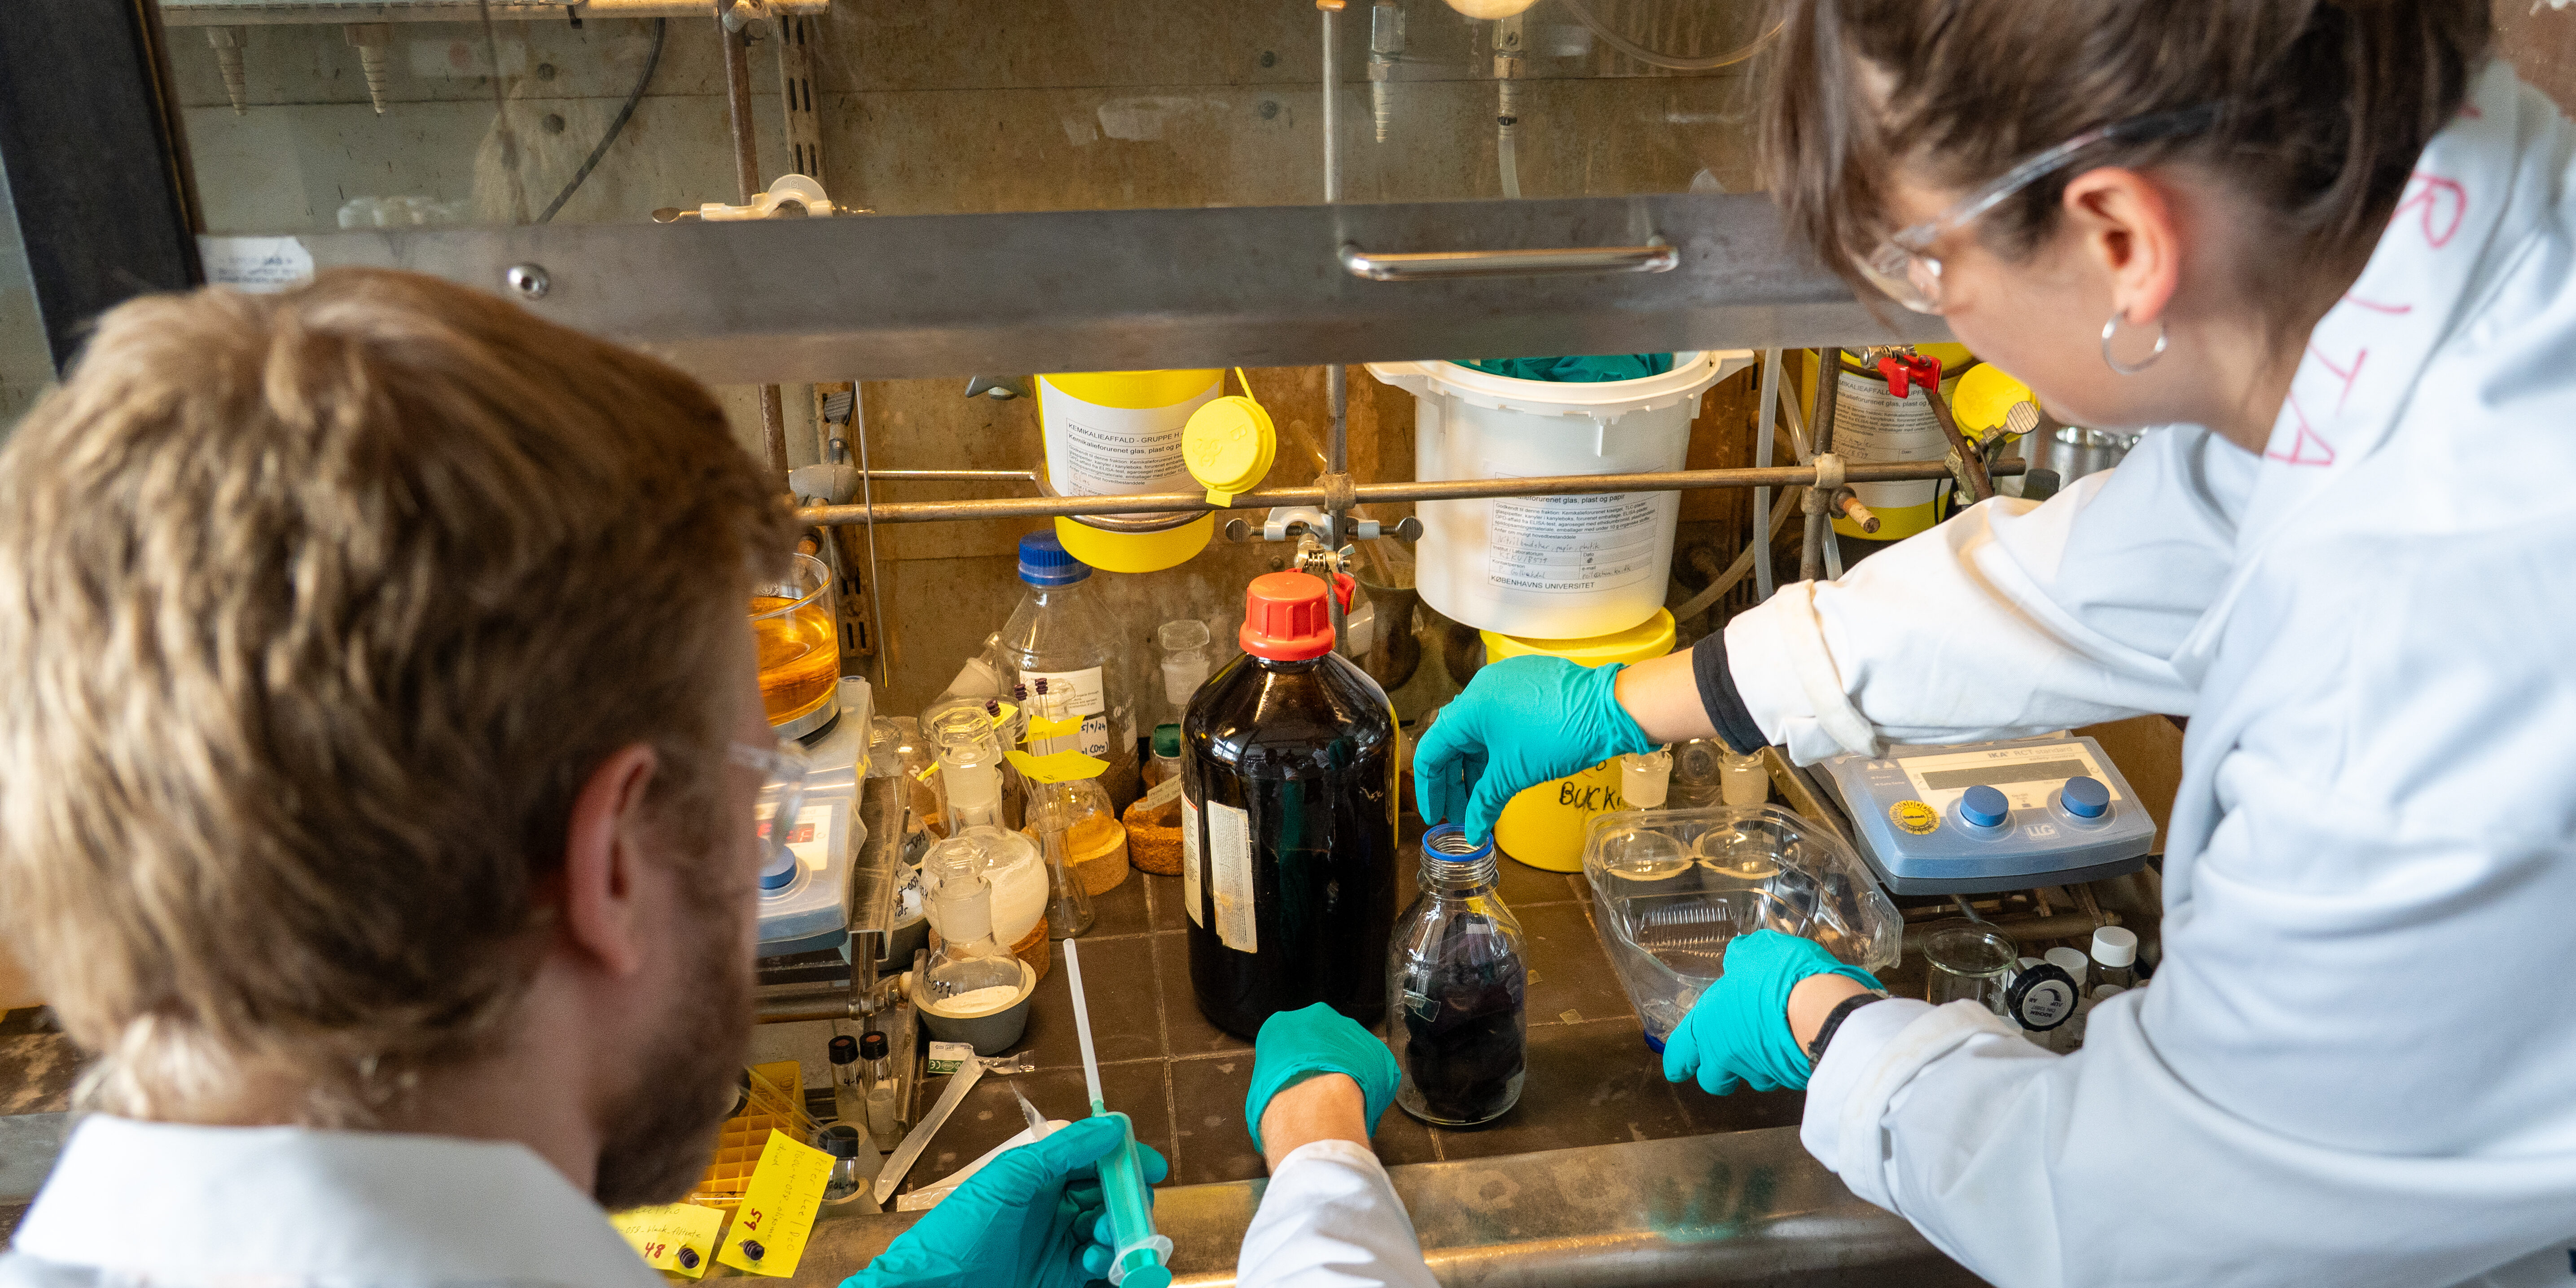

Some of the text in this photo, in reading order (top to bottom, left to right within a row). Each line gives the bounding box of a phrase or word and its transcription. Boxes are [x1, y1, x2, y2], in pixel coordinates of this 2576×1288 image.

[1069, 423, 1135, 443] KEMIKALIEAFFALD
[1141, 434, 1172, 443] GRUPPE
[1069, 433, 1128, 454] Kemikalieforurenet
[1069, 445, 1088, 456] Godkendt
[1130, 456, 1173, 464] Kemikalieforurenet
[1609, 494, 1625, 502] papir
[1496, 503, 1518, 512] Godkendt
[1512, 548, 1544, 556] Laboratorium
[1492, 559, 1525, 568] Kontaktperson
[1491, 575, 1543, 589] KØBENHAVNS
[2035, 746, 2073, 754] standard
[1559, 781, 1621, 811] BUCK
[644, 1242, 666, 1259] 48
